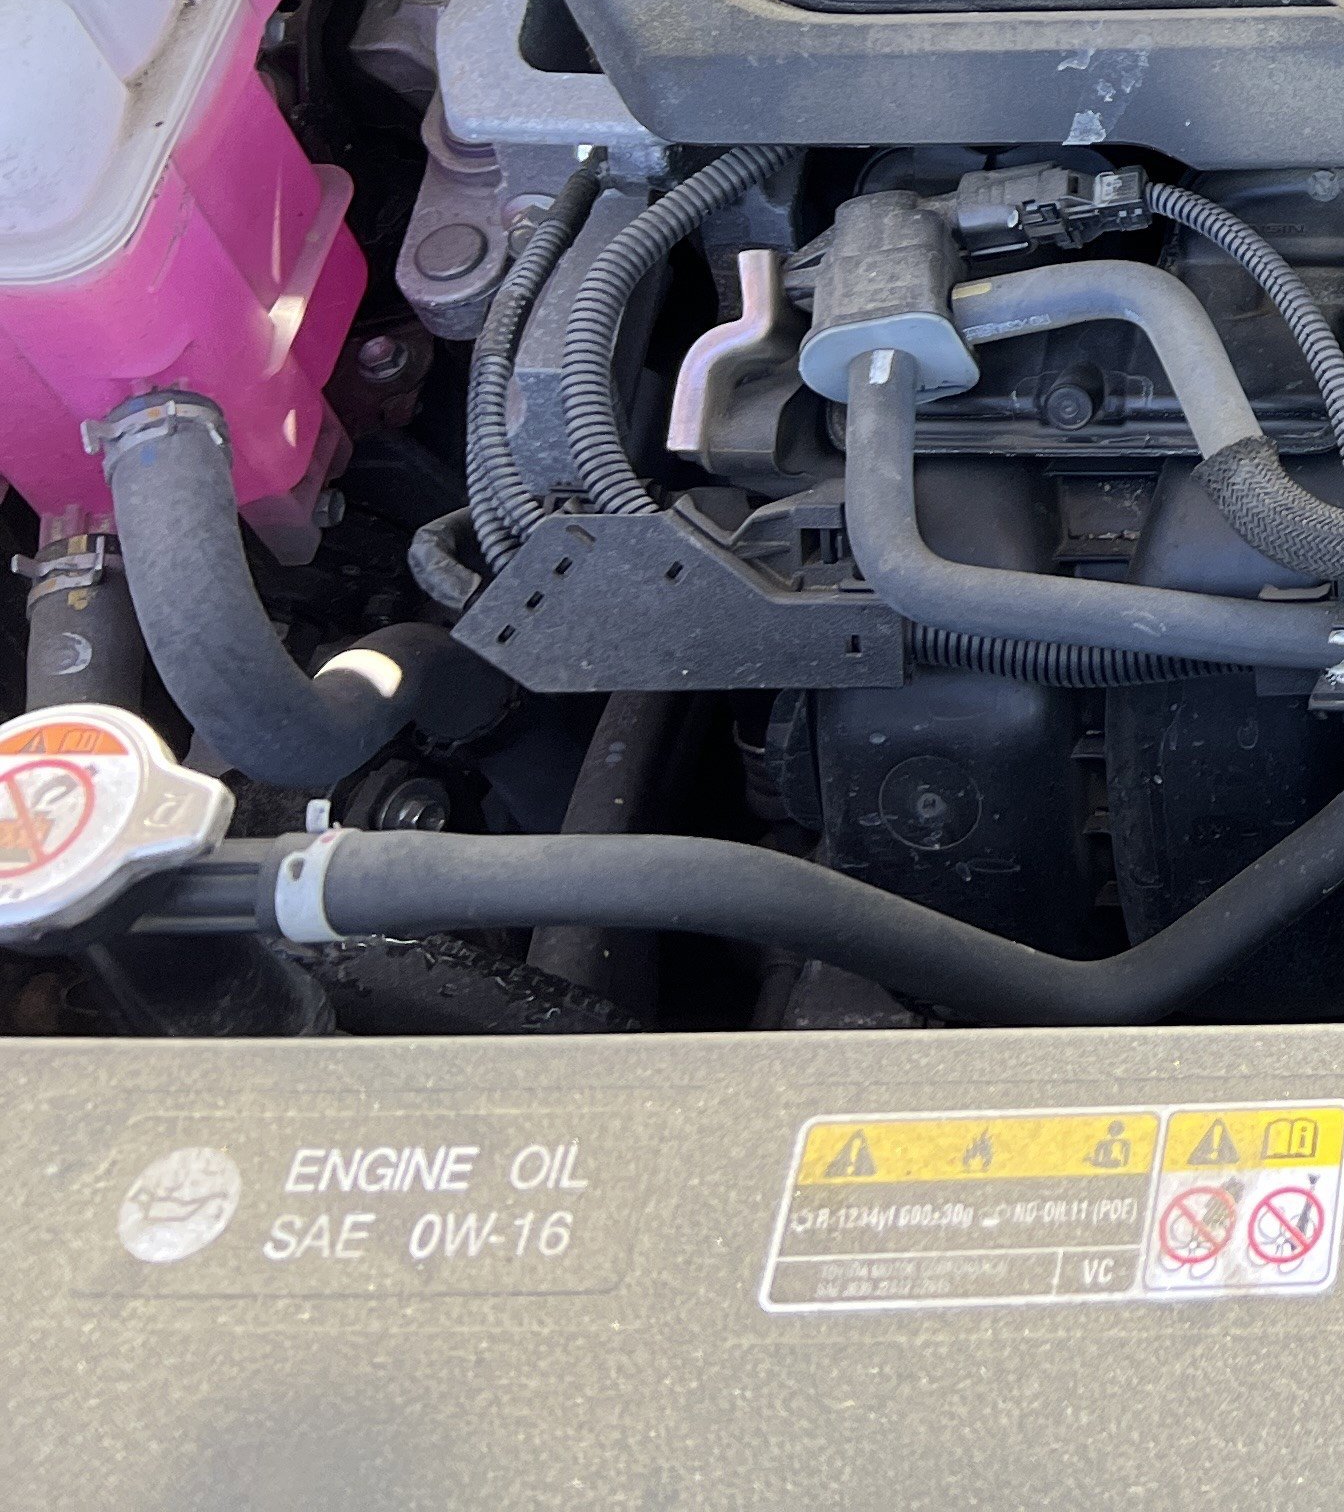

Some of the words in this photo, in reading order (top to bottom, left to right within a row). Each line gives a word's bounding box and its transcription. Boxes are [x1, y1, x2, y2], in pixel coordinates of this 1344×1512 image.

[284, 1145, 481, 1192] ENGINE
[508, 1143, 589, 1190] OIL
[263, 1212, 376, 1260] SAE
[408, 1210, 574, 1260] 0W-16
[1083, 1258, 1115, 1285] VC
